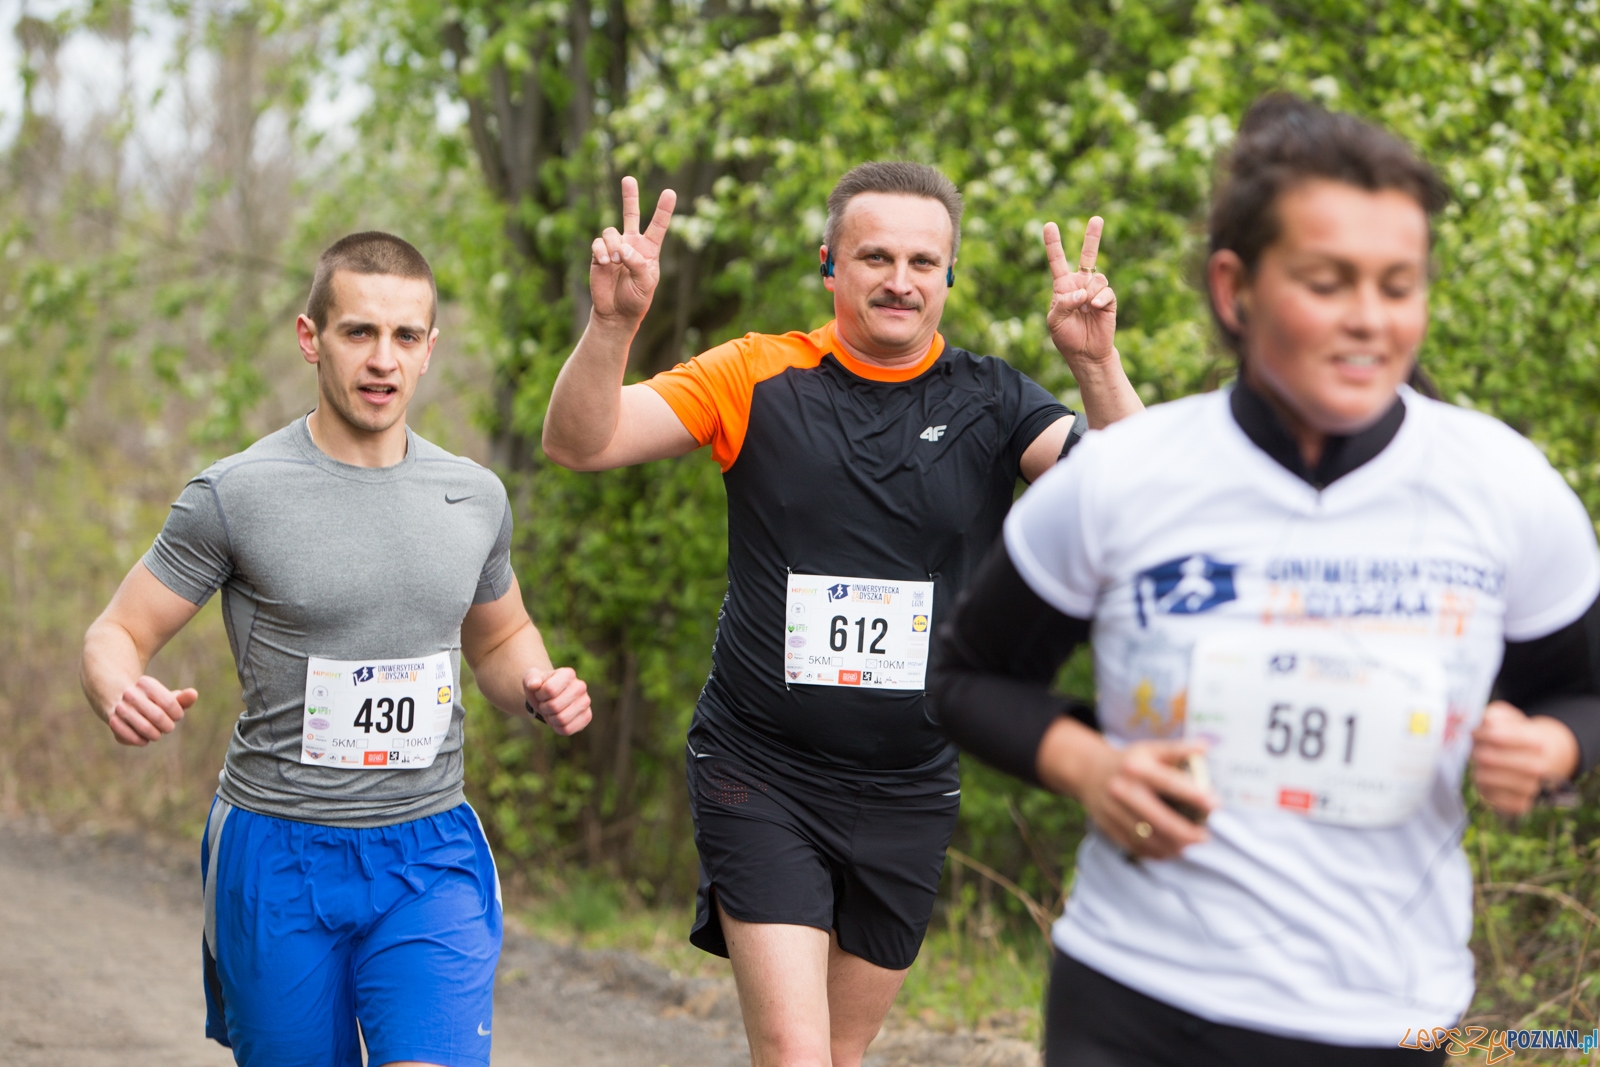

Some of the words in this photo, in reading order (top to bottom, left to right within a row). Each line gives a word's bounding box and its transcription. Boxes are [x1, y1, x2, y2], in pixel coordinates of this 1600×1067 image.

[920, 425, 947, 441] 4F
[852, 584, 899, 594] UNIWERSYTECKA
[883, 594, 892, 604] IV
[829, 615, 888, 654] 612
[377, 663, 425, 672] UNIWERSYTECKA
[808, 656, 831, 665] 5KM
[878, 660, 905, 669] 10KM
[409, 671, 418, 682] IV
[353, 696, 415, 734] 430
[1265, 704, 1359, 766] 581
[332, 738, 356, 748] 5KM
[406, 736, 432, 747] 10KM
